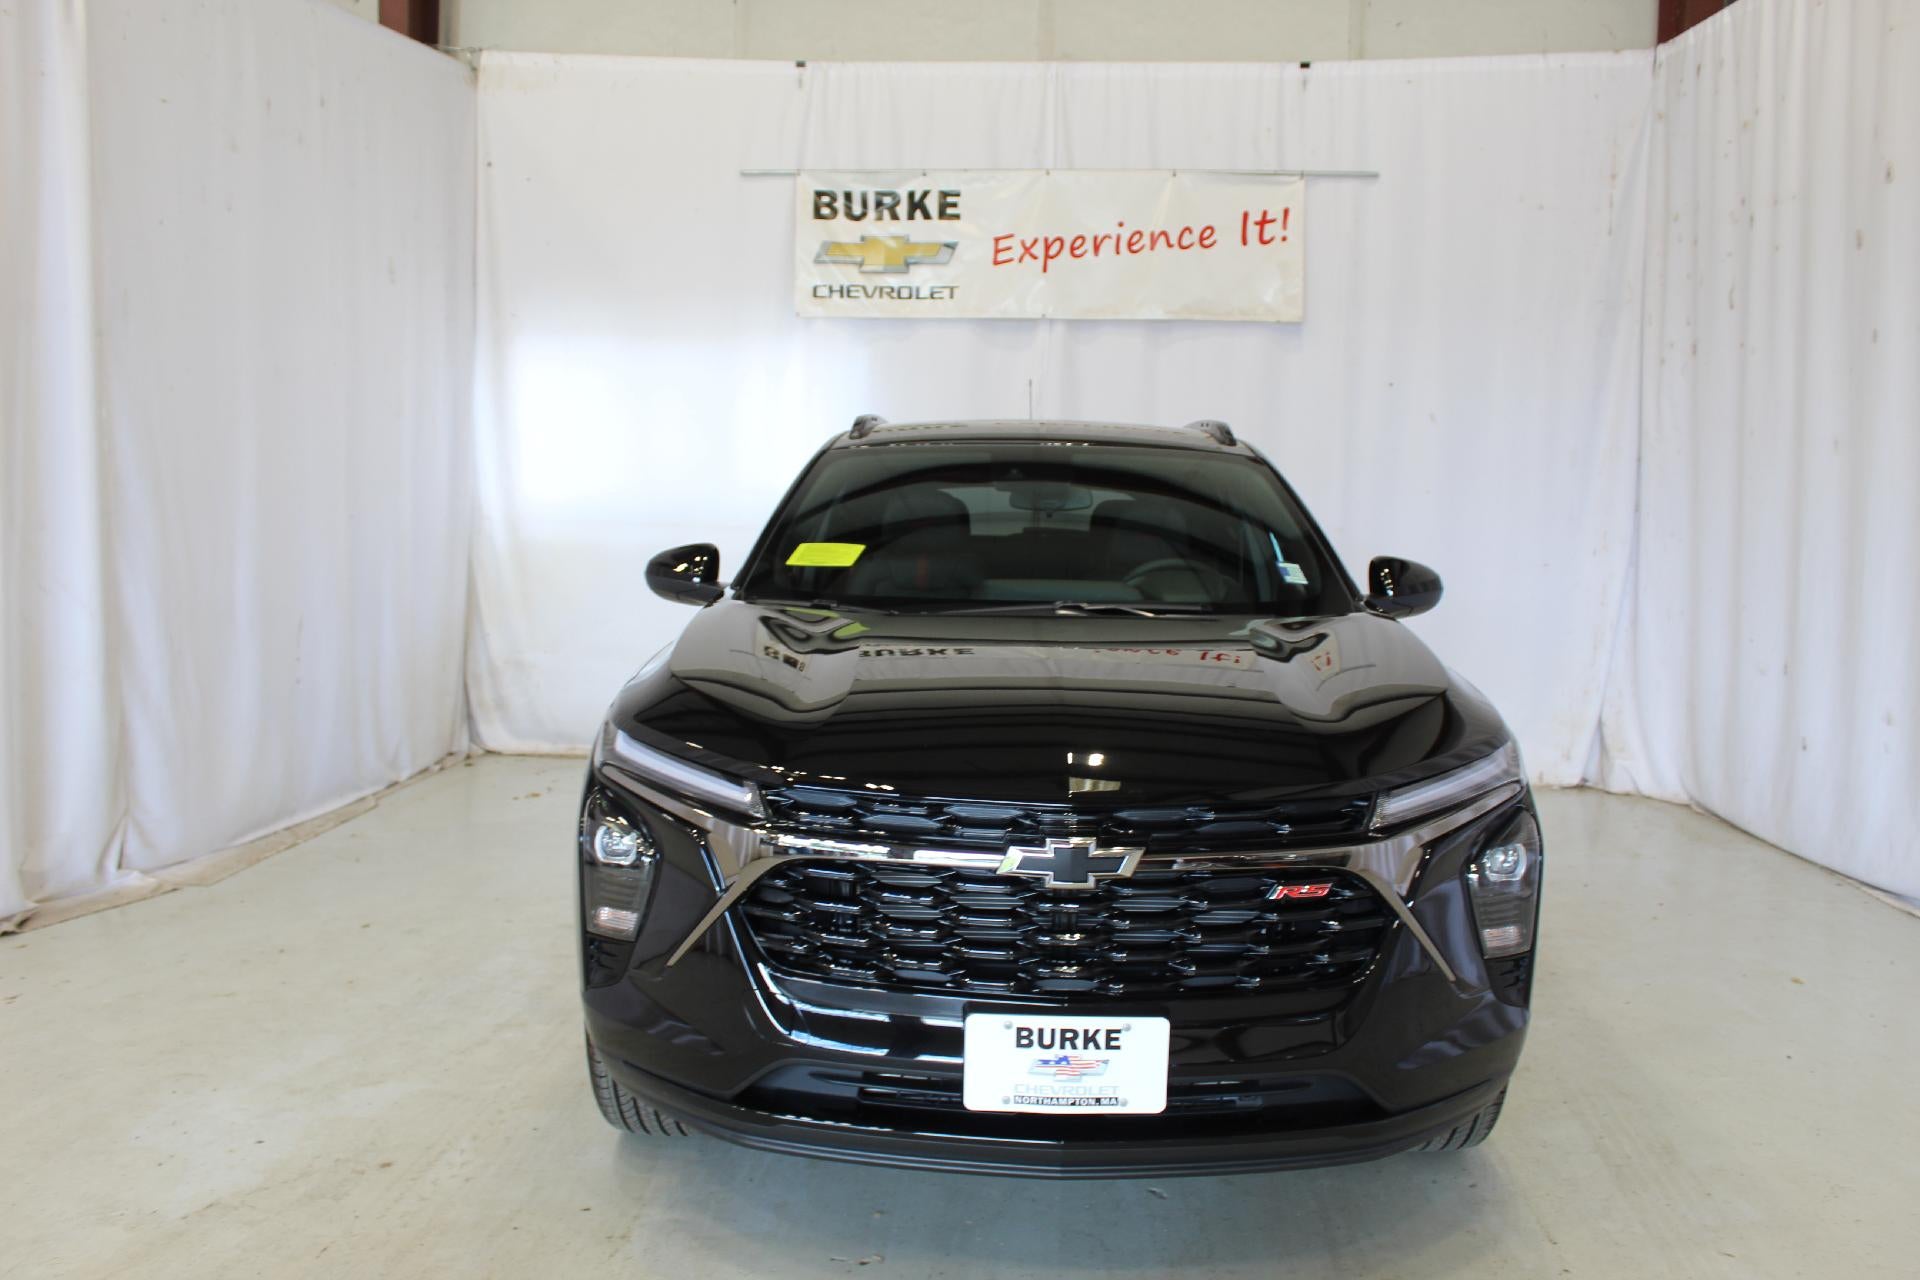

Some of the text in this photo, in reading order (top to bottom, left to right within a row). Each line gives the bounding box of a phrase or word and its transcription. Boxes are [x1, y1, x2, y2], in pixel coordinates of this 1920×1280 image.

[813, 190, 961, 221] BURKE
[991, 208, 1292, 273] Experience It!
[813, 284, 960, 300] CHEVROLET
[1269, 884, 1333, 899] RS
[1016, 1027, 1122, 1050] BURKE
[1014, 1083, 1119, 1096] CHEVROLET
